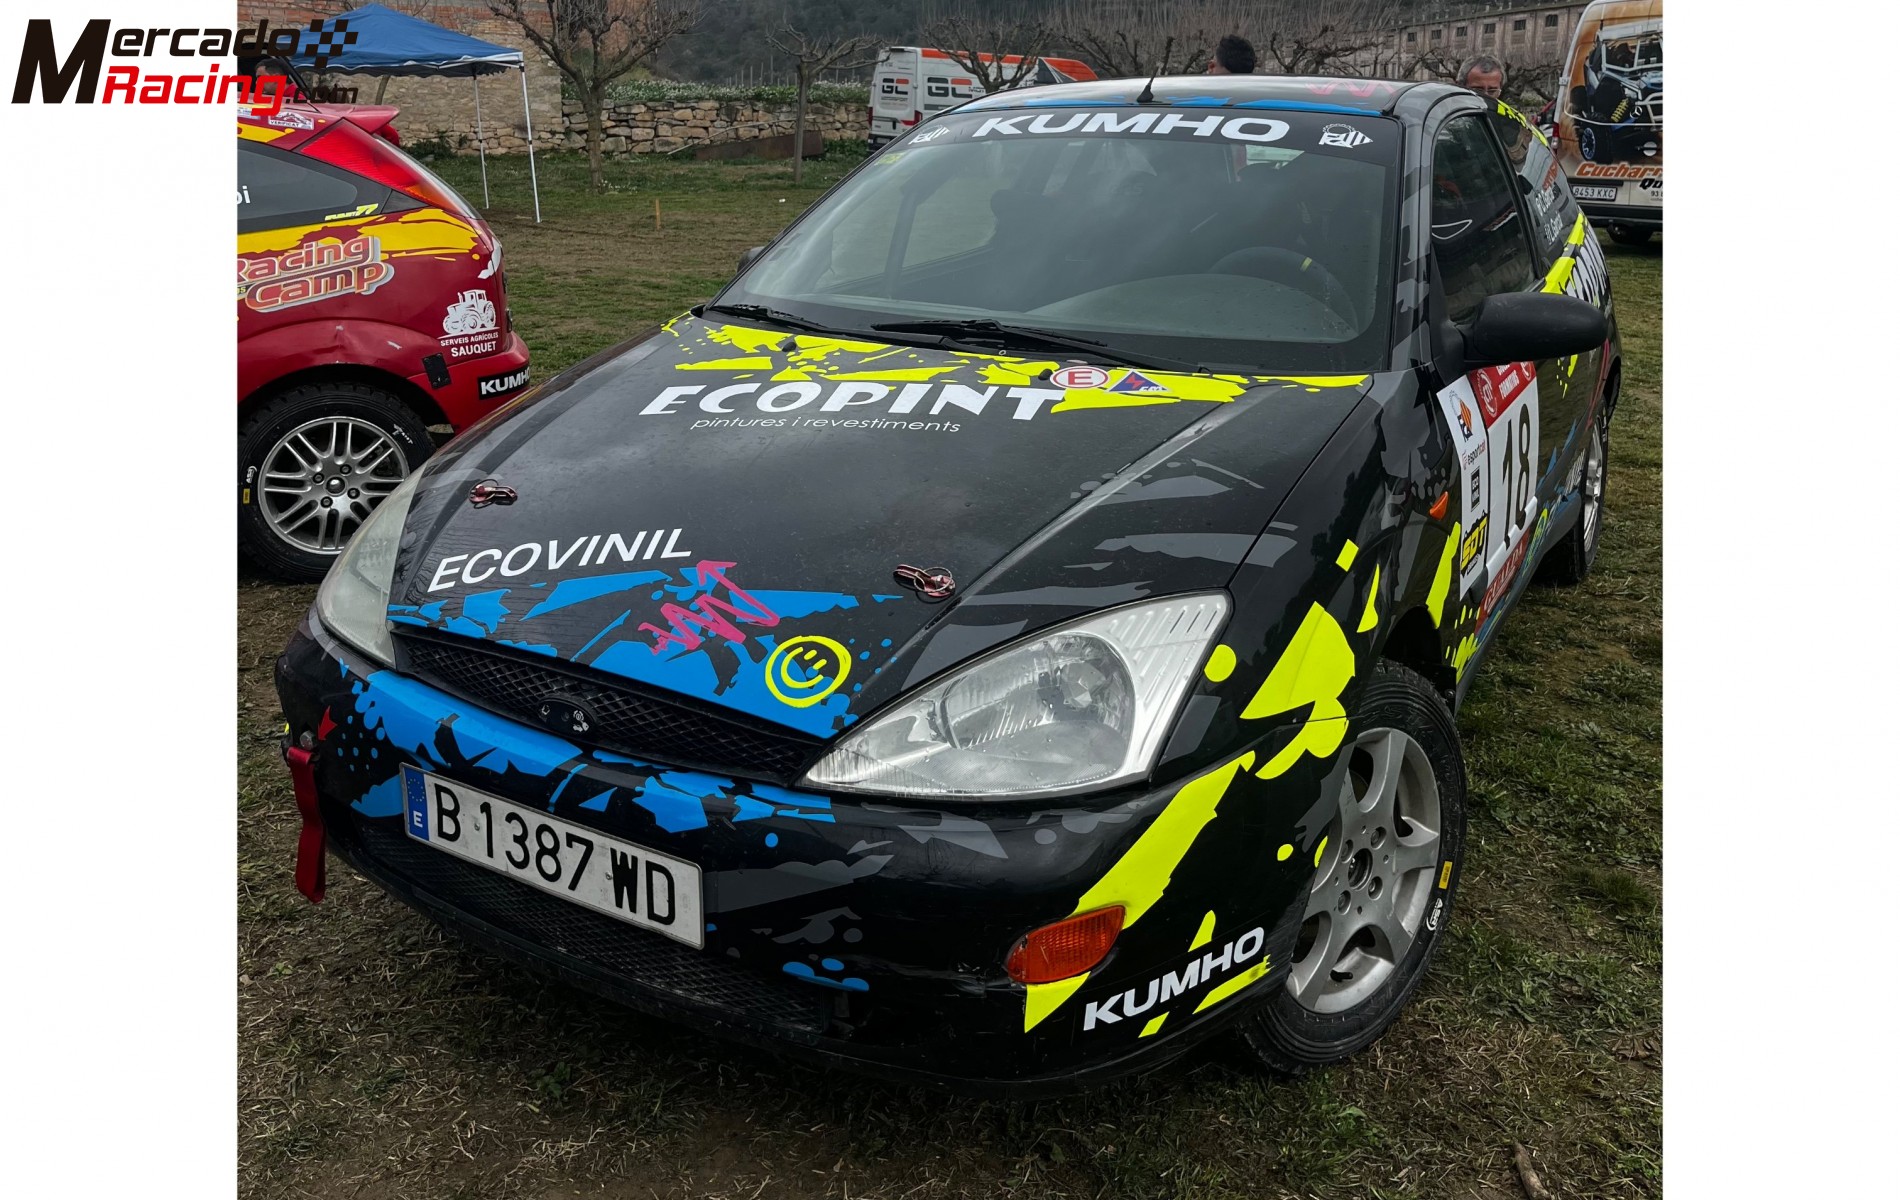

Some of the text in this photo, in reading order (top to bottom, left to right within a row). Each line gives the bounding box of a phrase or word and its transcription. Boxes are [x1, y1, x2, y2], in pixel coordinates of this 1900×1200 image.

[972, 112, 1290, 142] KUMHO
[1596, 188, 1614, 198] KXC
[440, 336, 469, 347] SERVEIS
[450, 340, 497, 358] SAUQUET
[638, 383, 1066, 422] ECOPINT
[690, 414, 961, 433] pintures i revestiments
[1502, 403, 1531, 551] 18
[427, 528, 692, 593] ECOVINIL
[413, 810, 423, 828] E
[434, 783, 676, 926] B 1387 WD
[1083, 926, 1264, 1031] KUMHO
